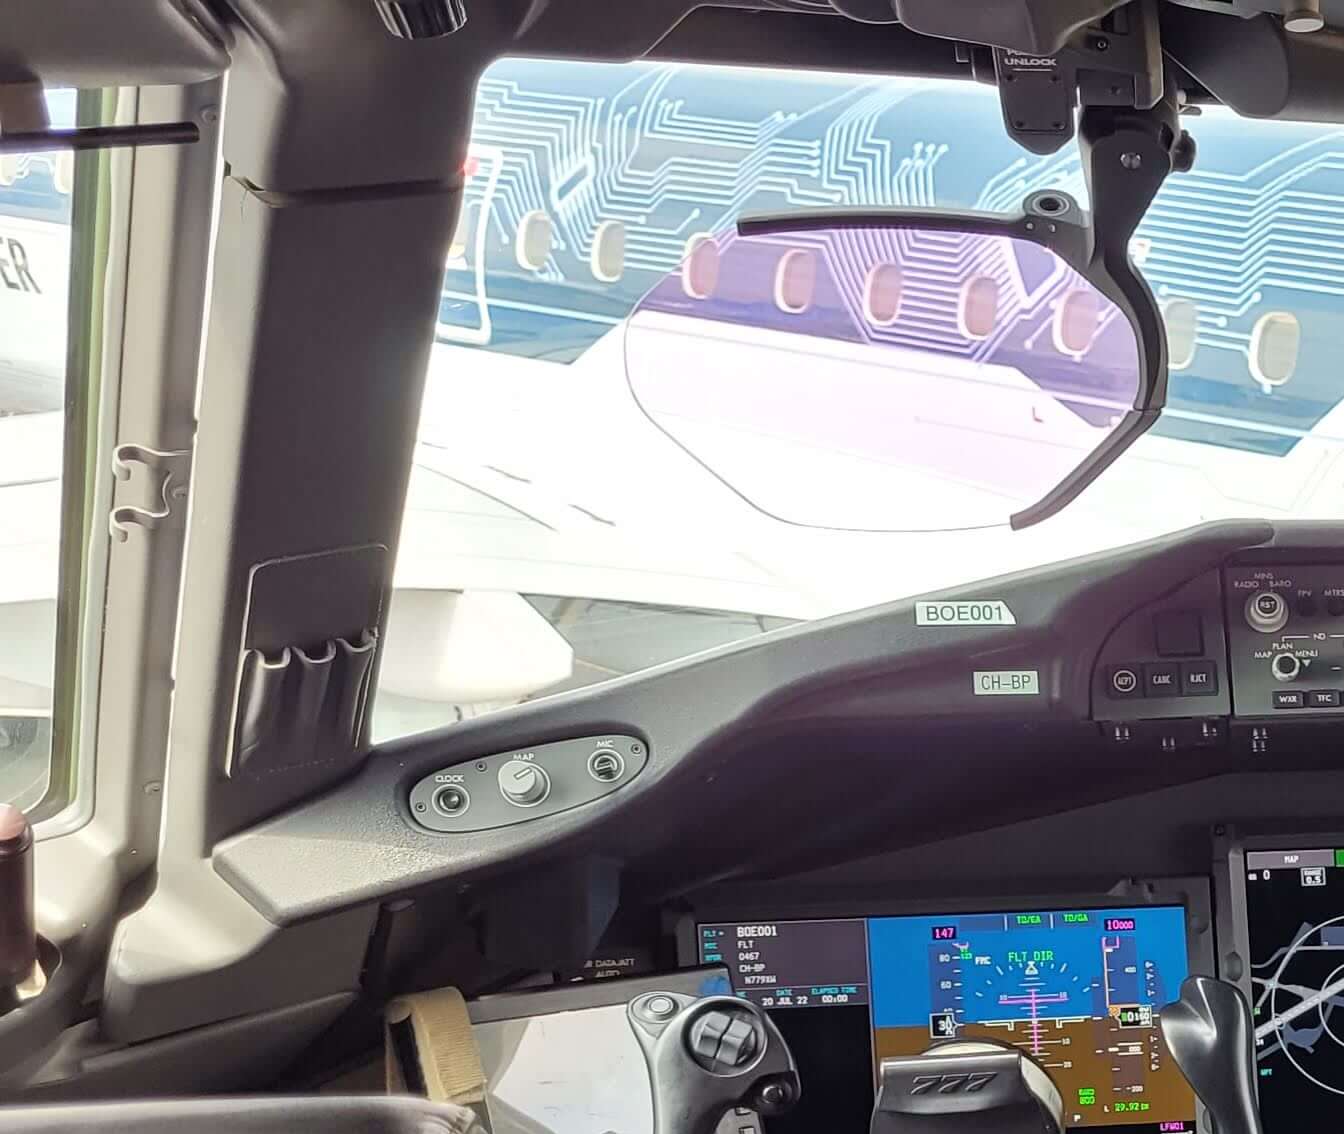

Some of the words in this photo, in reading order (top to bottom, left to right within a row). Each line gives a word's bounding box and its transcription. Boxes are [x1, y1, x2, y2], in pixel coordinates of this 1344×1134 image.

[926, 605, 1003, 622] BOE001
[1272, 642, 1294, 650] PLAN
[1254, 651, 1273, 659] MAP
[981, 674, 1031, 690] CH-BP
[737, 925, 777, 938] BOE001
[935, 927, 954, 939] 147
[1008, 951, 1030, 963] FLT
[1033, 949, 1053, 961] DIR
[777, 996, 797, 1006] JUL
[911, 1072, 998, 1094] 777
